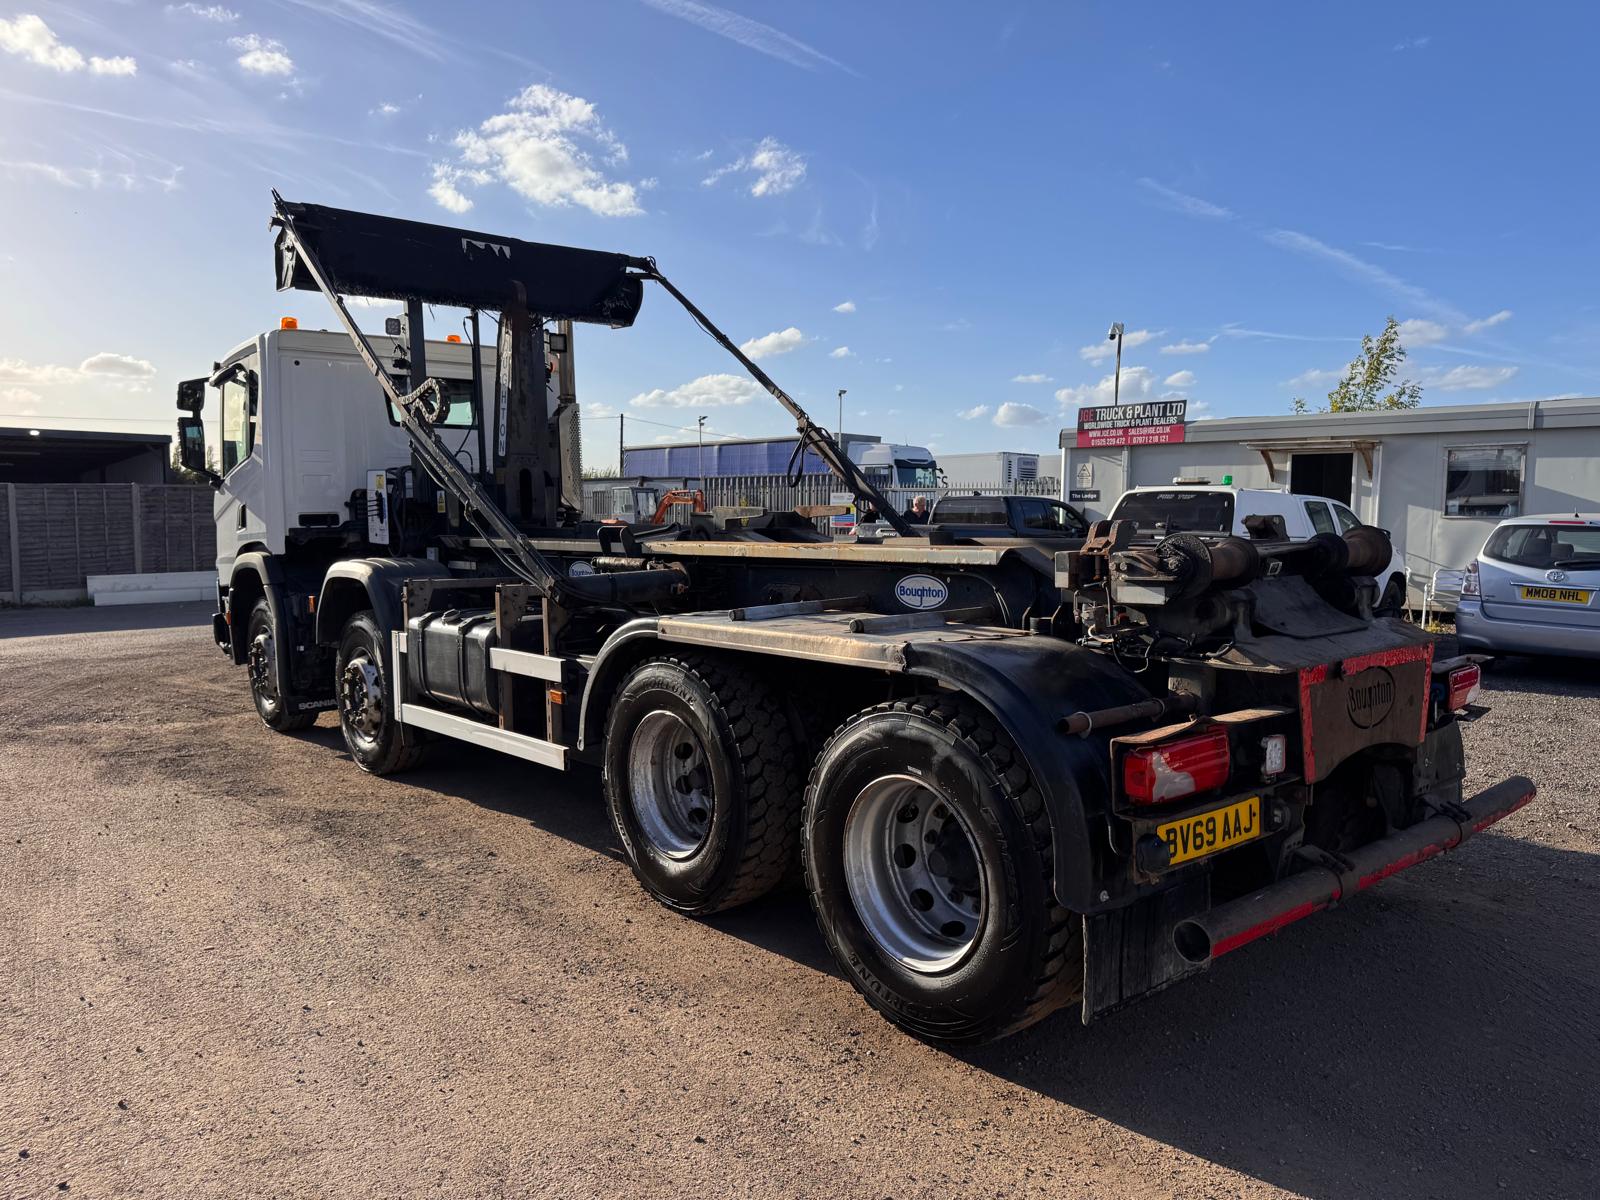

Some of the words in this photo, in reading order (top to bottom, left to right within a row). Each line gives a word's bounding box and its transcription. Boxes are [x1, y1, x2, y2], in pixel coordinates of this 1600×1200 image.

[1080, 409, 1094, 422] JGE
[1095, 406, 1125, 421] TRUCK
[1126, 406, 1133, 419] &
[1134, 404, 1166, 418] PLANT
[1166, 402, 1185, 416] LTD
[1083, 421, 1113, 430] WORLDWIDE
[1114, 420, 1130, 428] TRUCK
[1135, 418, 1153, 426] PLANT
[1153, 416, 1178, 425] DEALERS
[899, 585, 944, 605] Boughton
[1525, 587, 1556, 600] MM08
[1560, 589, 1583, 602] NHL
[298, 699, 338, 710] SCANIA
[1165, 816, 1217, 858] BV69
[1222, 803, 1253, 842] AAJ
